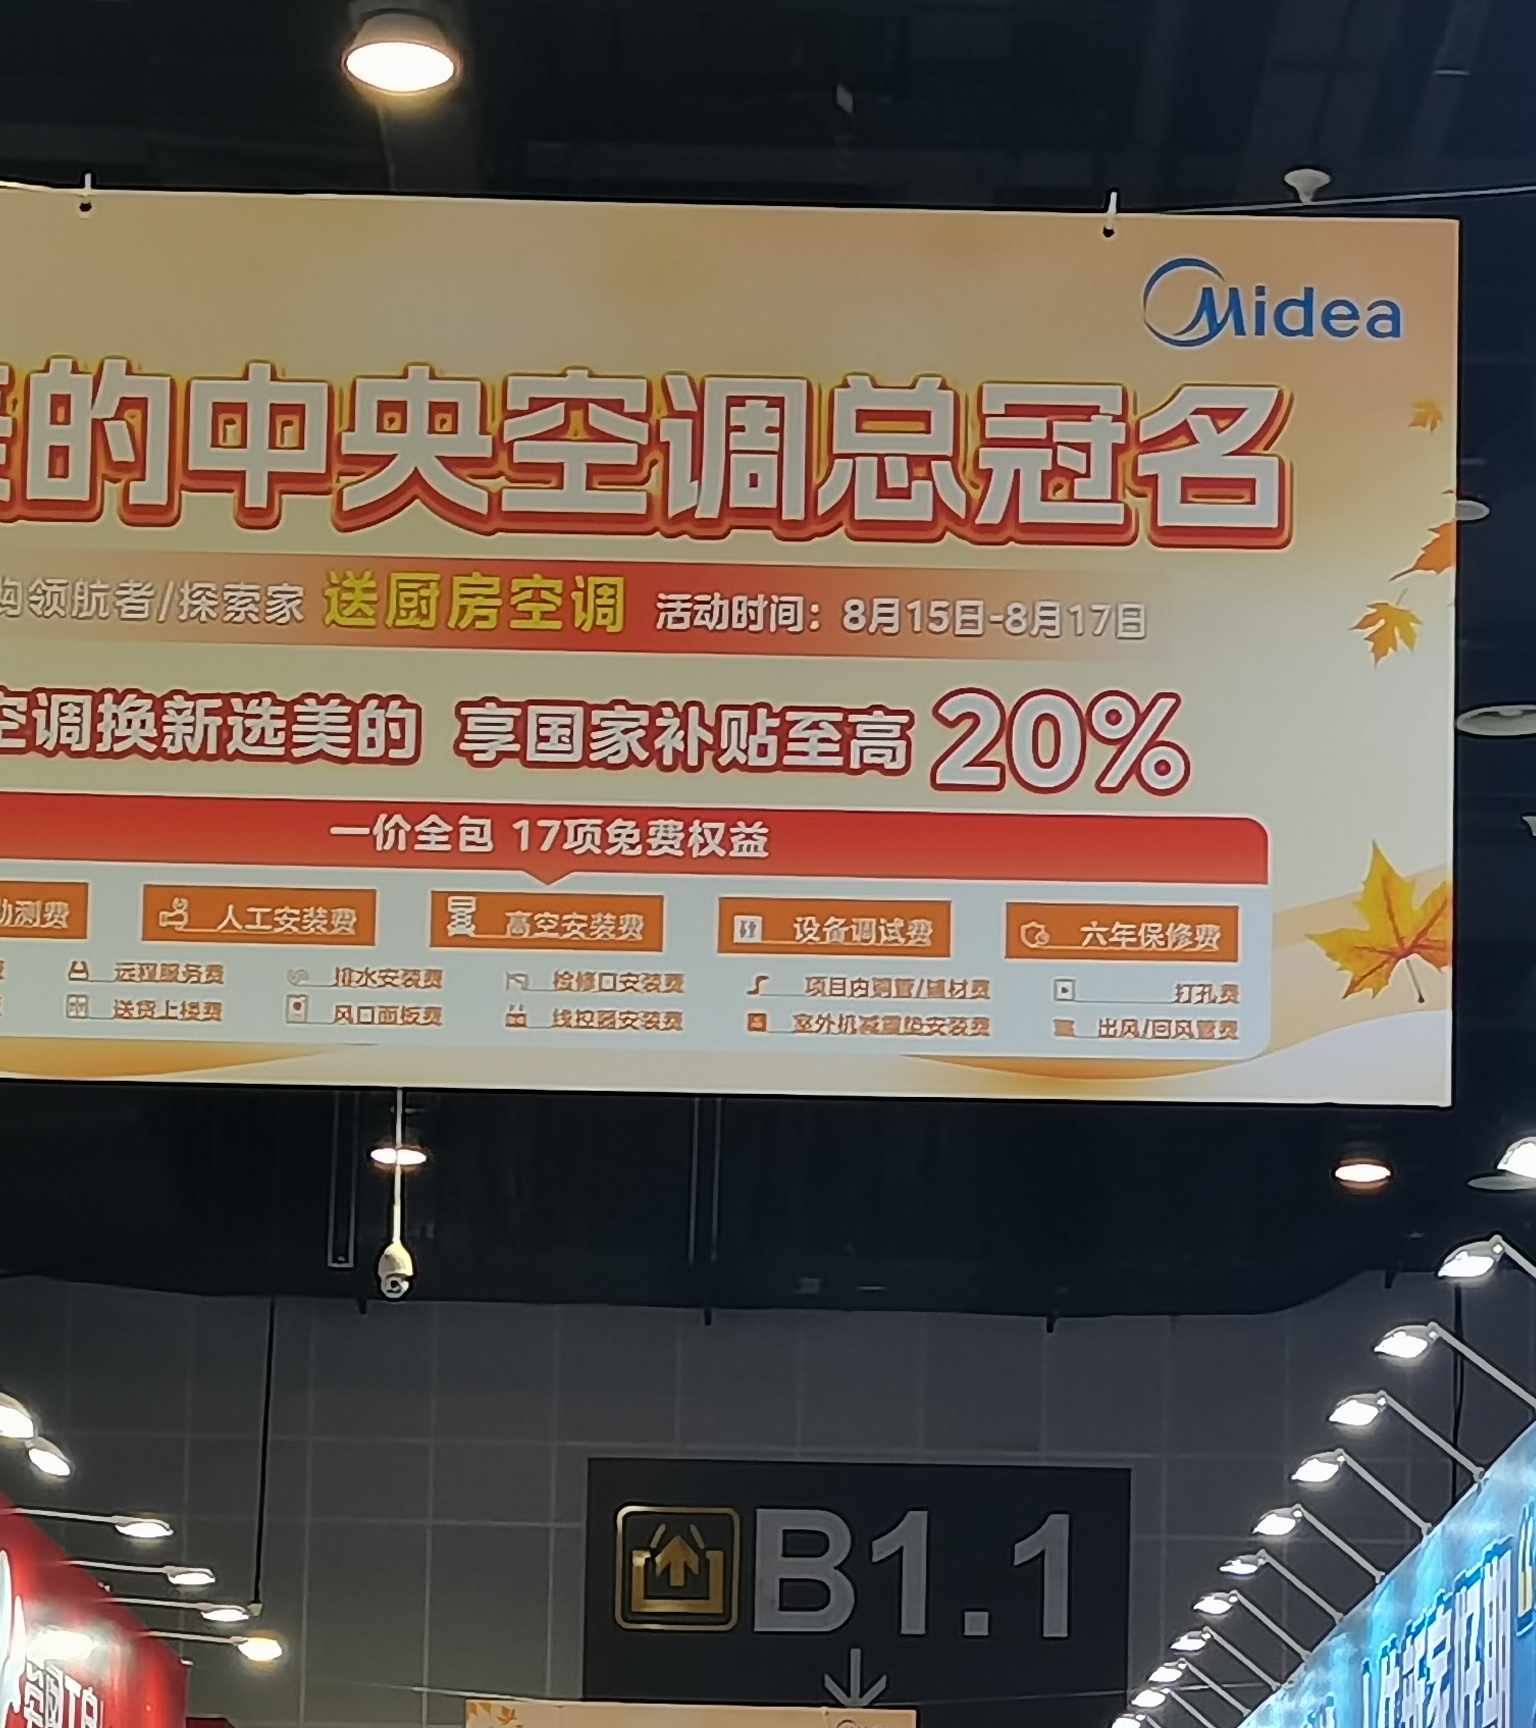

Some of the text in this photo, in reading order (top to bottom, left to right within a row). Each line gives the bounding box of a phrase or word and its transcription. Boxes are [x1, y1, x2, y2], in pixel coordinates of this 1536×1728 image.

[1143, 257, 1405, 347] Midea
[323, 569, 627, 634] 送厨房空调
[328, 813, 771, 861] 一价全包 17项免费权益
[215, 903, 359, 937] 人工安装费
[505, 909, 645, 943] 高空安装费
[793, 915, 934, 949] 设备调试费
[1080, 921, 1222, 954] 六年保修费
[753, 1507, 1071, 1638] B1.1
